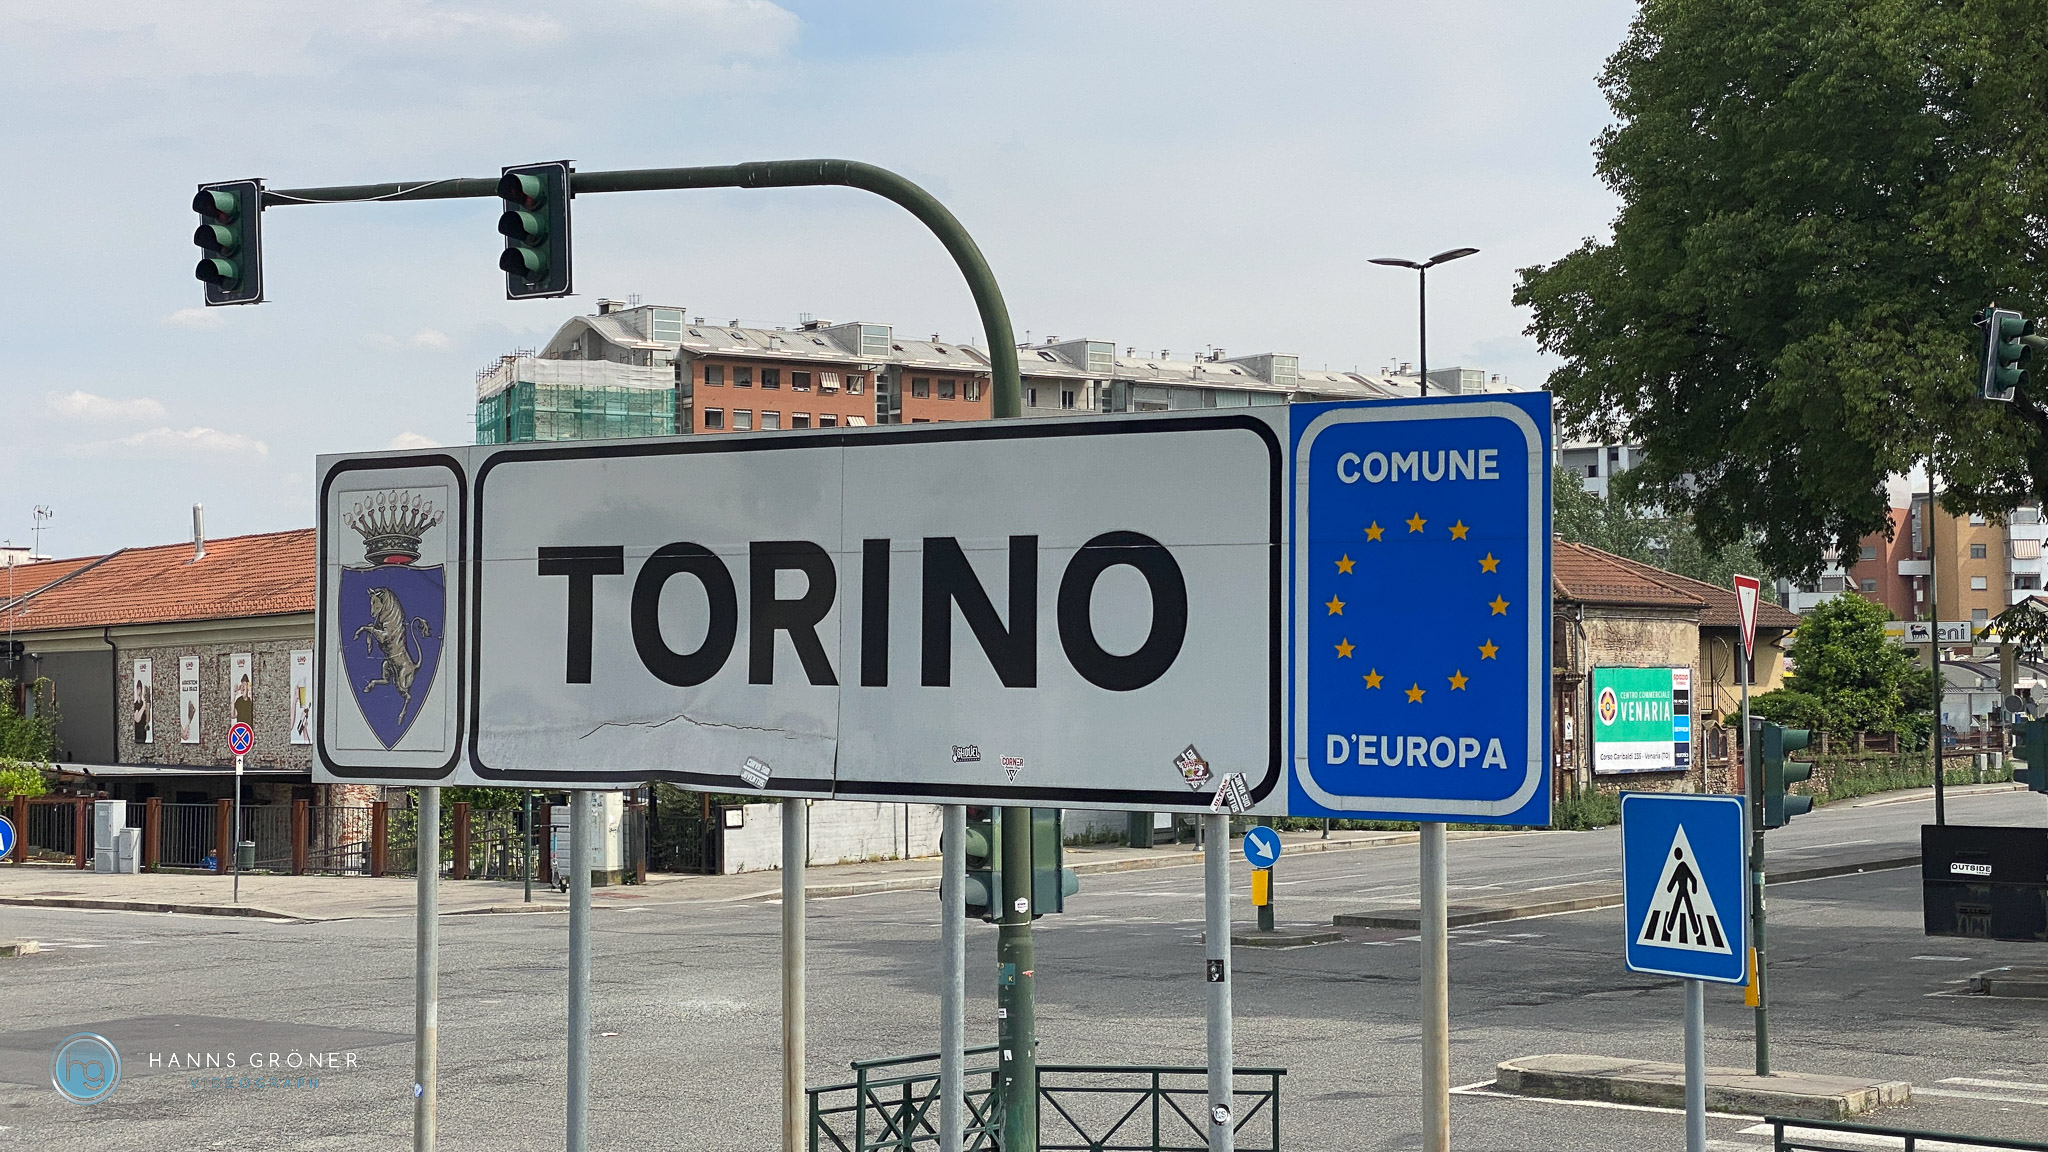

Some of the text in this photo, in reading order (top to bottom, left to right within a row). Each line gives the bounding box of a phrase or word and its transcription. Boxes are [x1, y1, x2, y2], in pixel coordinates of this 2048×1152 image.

[1337, 448, 1500, 484] COMUNE
[537, 530, 1188, 692] TORINO
[1937, 624, 1965, 640] eni
[1620, 690, 1670, 700] CENTRO COMMERCIALE
[1620, 701, 1671, 721] VENARIA
[1327, 733, 1507, 769] D'EUROPA
[1001, 757, 1024, 767] CORNER
[1952, 863, 1991, 872] OUTSIDE
